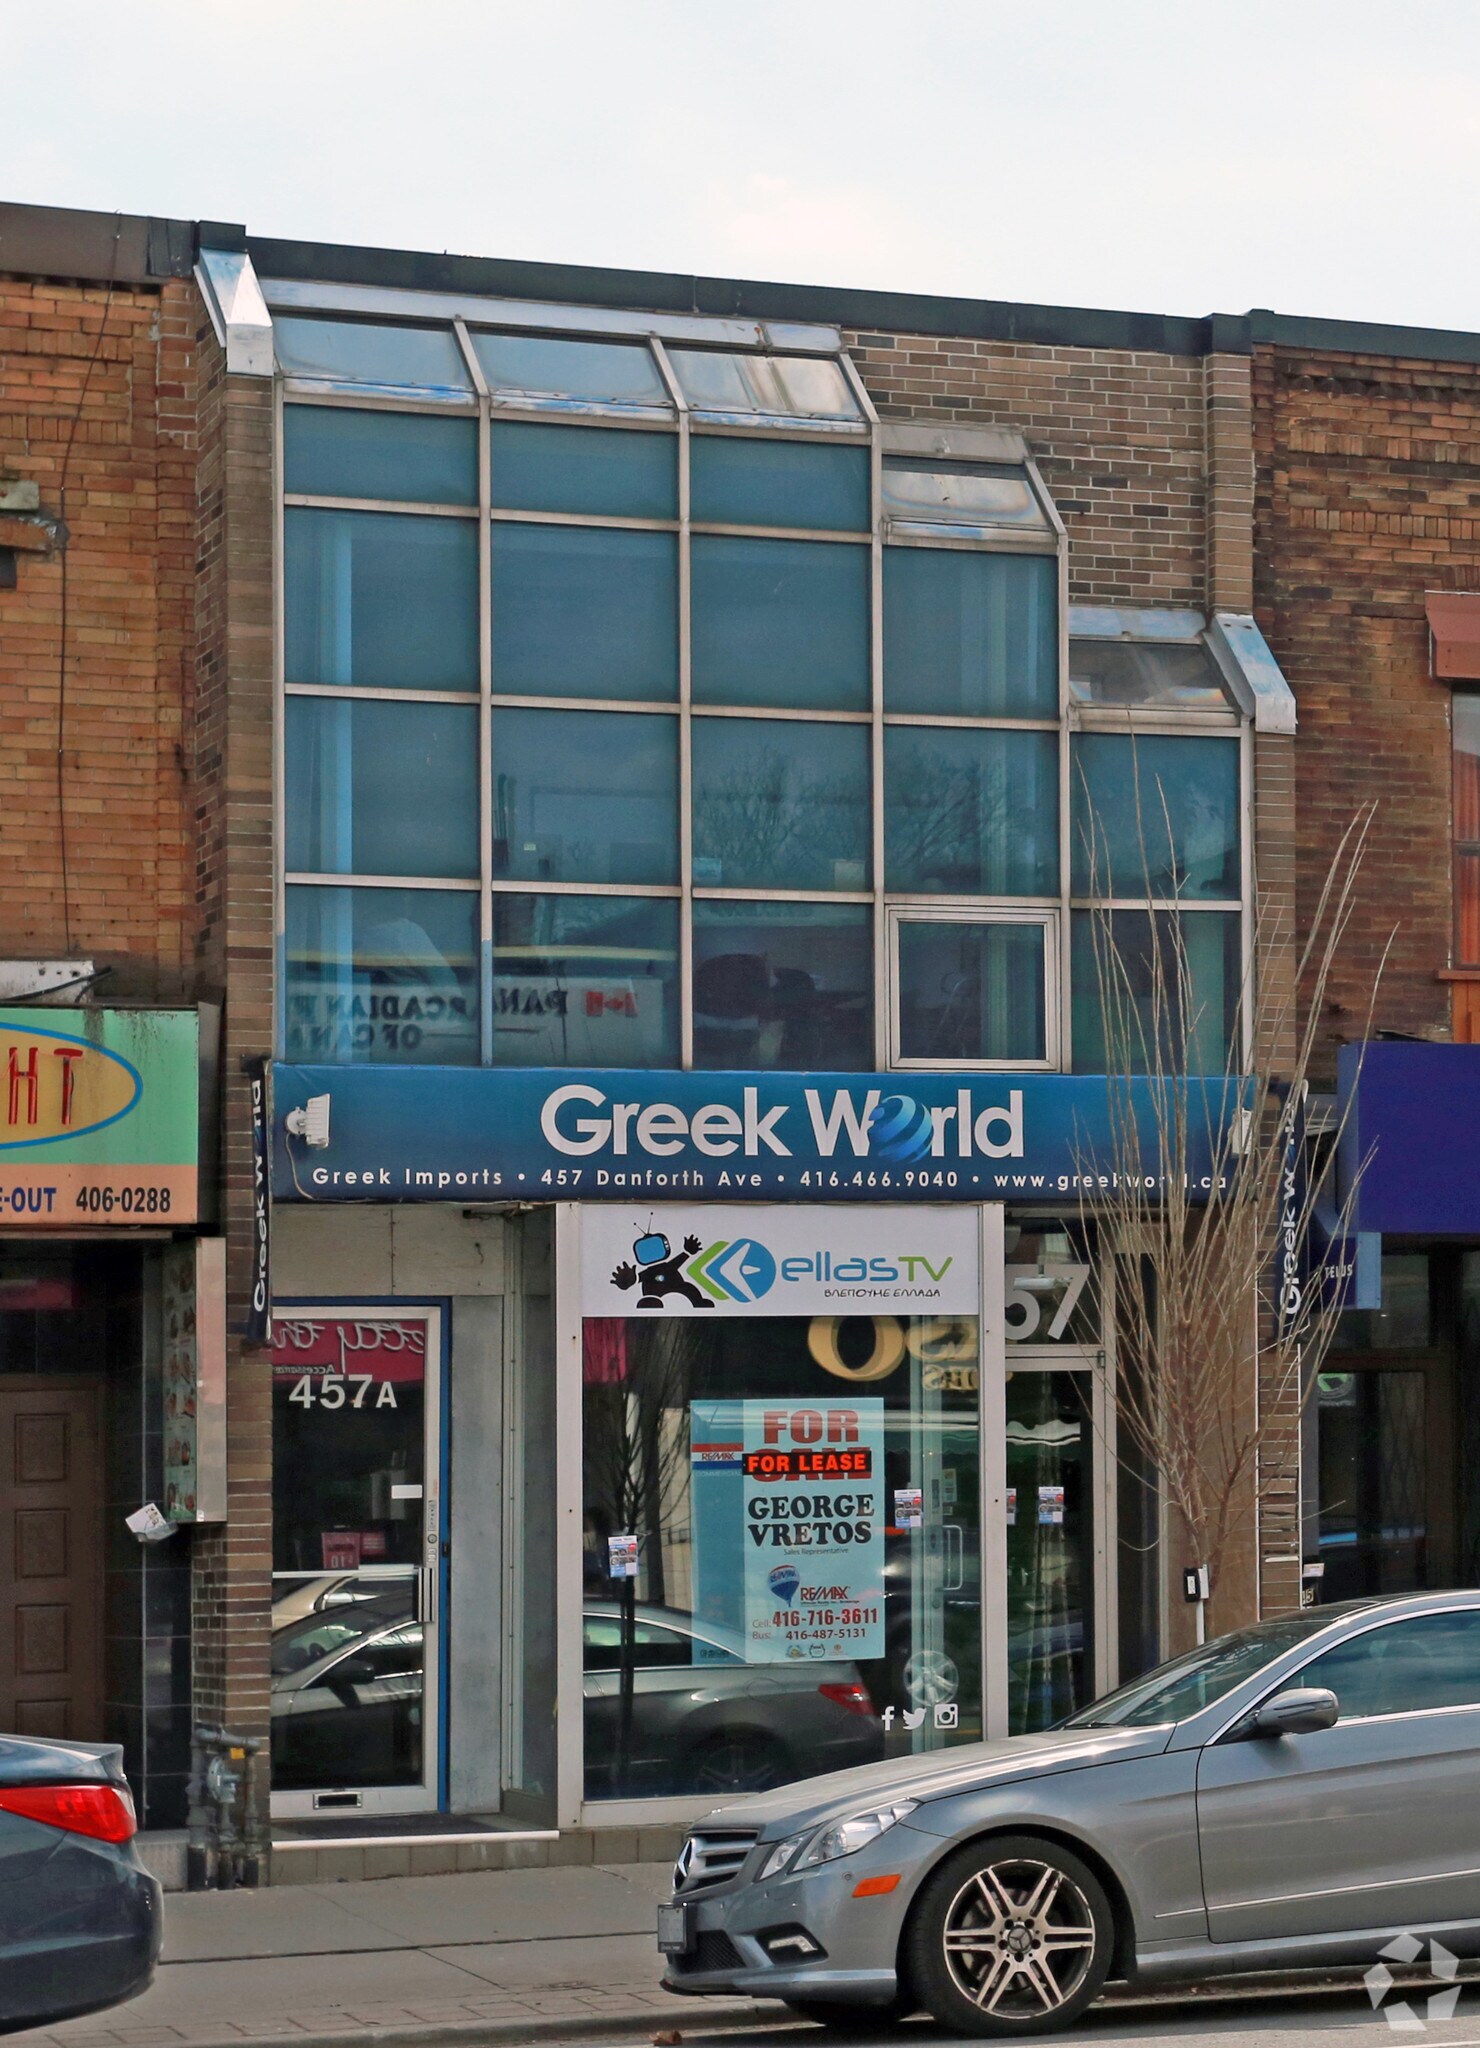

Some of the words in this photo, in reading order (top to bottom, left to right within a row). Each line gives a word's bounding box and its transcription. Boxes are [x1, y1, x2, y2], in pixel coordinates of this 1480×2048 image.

[540, 1084, 793, 1157] Greek
[312, 1167, 391, 1186] Greek
[406, 1168, 502, 1188] Imports
[541, 1169, 583, 1186] 457
[598, 1169, 704, 1187] Danforth
[717, 1170, 763, 1187] Ave
[800, 1171, 959, 1188] 416.466.9040
[0, 1187, 57, 1213] -OUT
[76, 1186, 171, 1213] 406-0288
[1324, 1263, 1353, 1279] TELUS
[288, 1373, 398, 1409] 457A
[763, 1409, 859, 1444] FOR
[701, 1451, 735, 1462] RE/MAX
[747, 1455, 790, 1474] FOR
[799, 1453, 867, 1472] LEASE
[747, 1494, 875, 1520] GEORGE
[747, 1521, 873, 1547] VRETOS
[783, 1548, 800, 1556] Sales
[800, 1586, 849, 1601] RE/MAX
[772, 1607, 878, 1628] 416-716-3611
[785, 1628, 866, 1641] 416-487-5131
